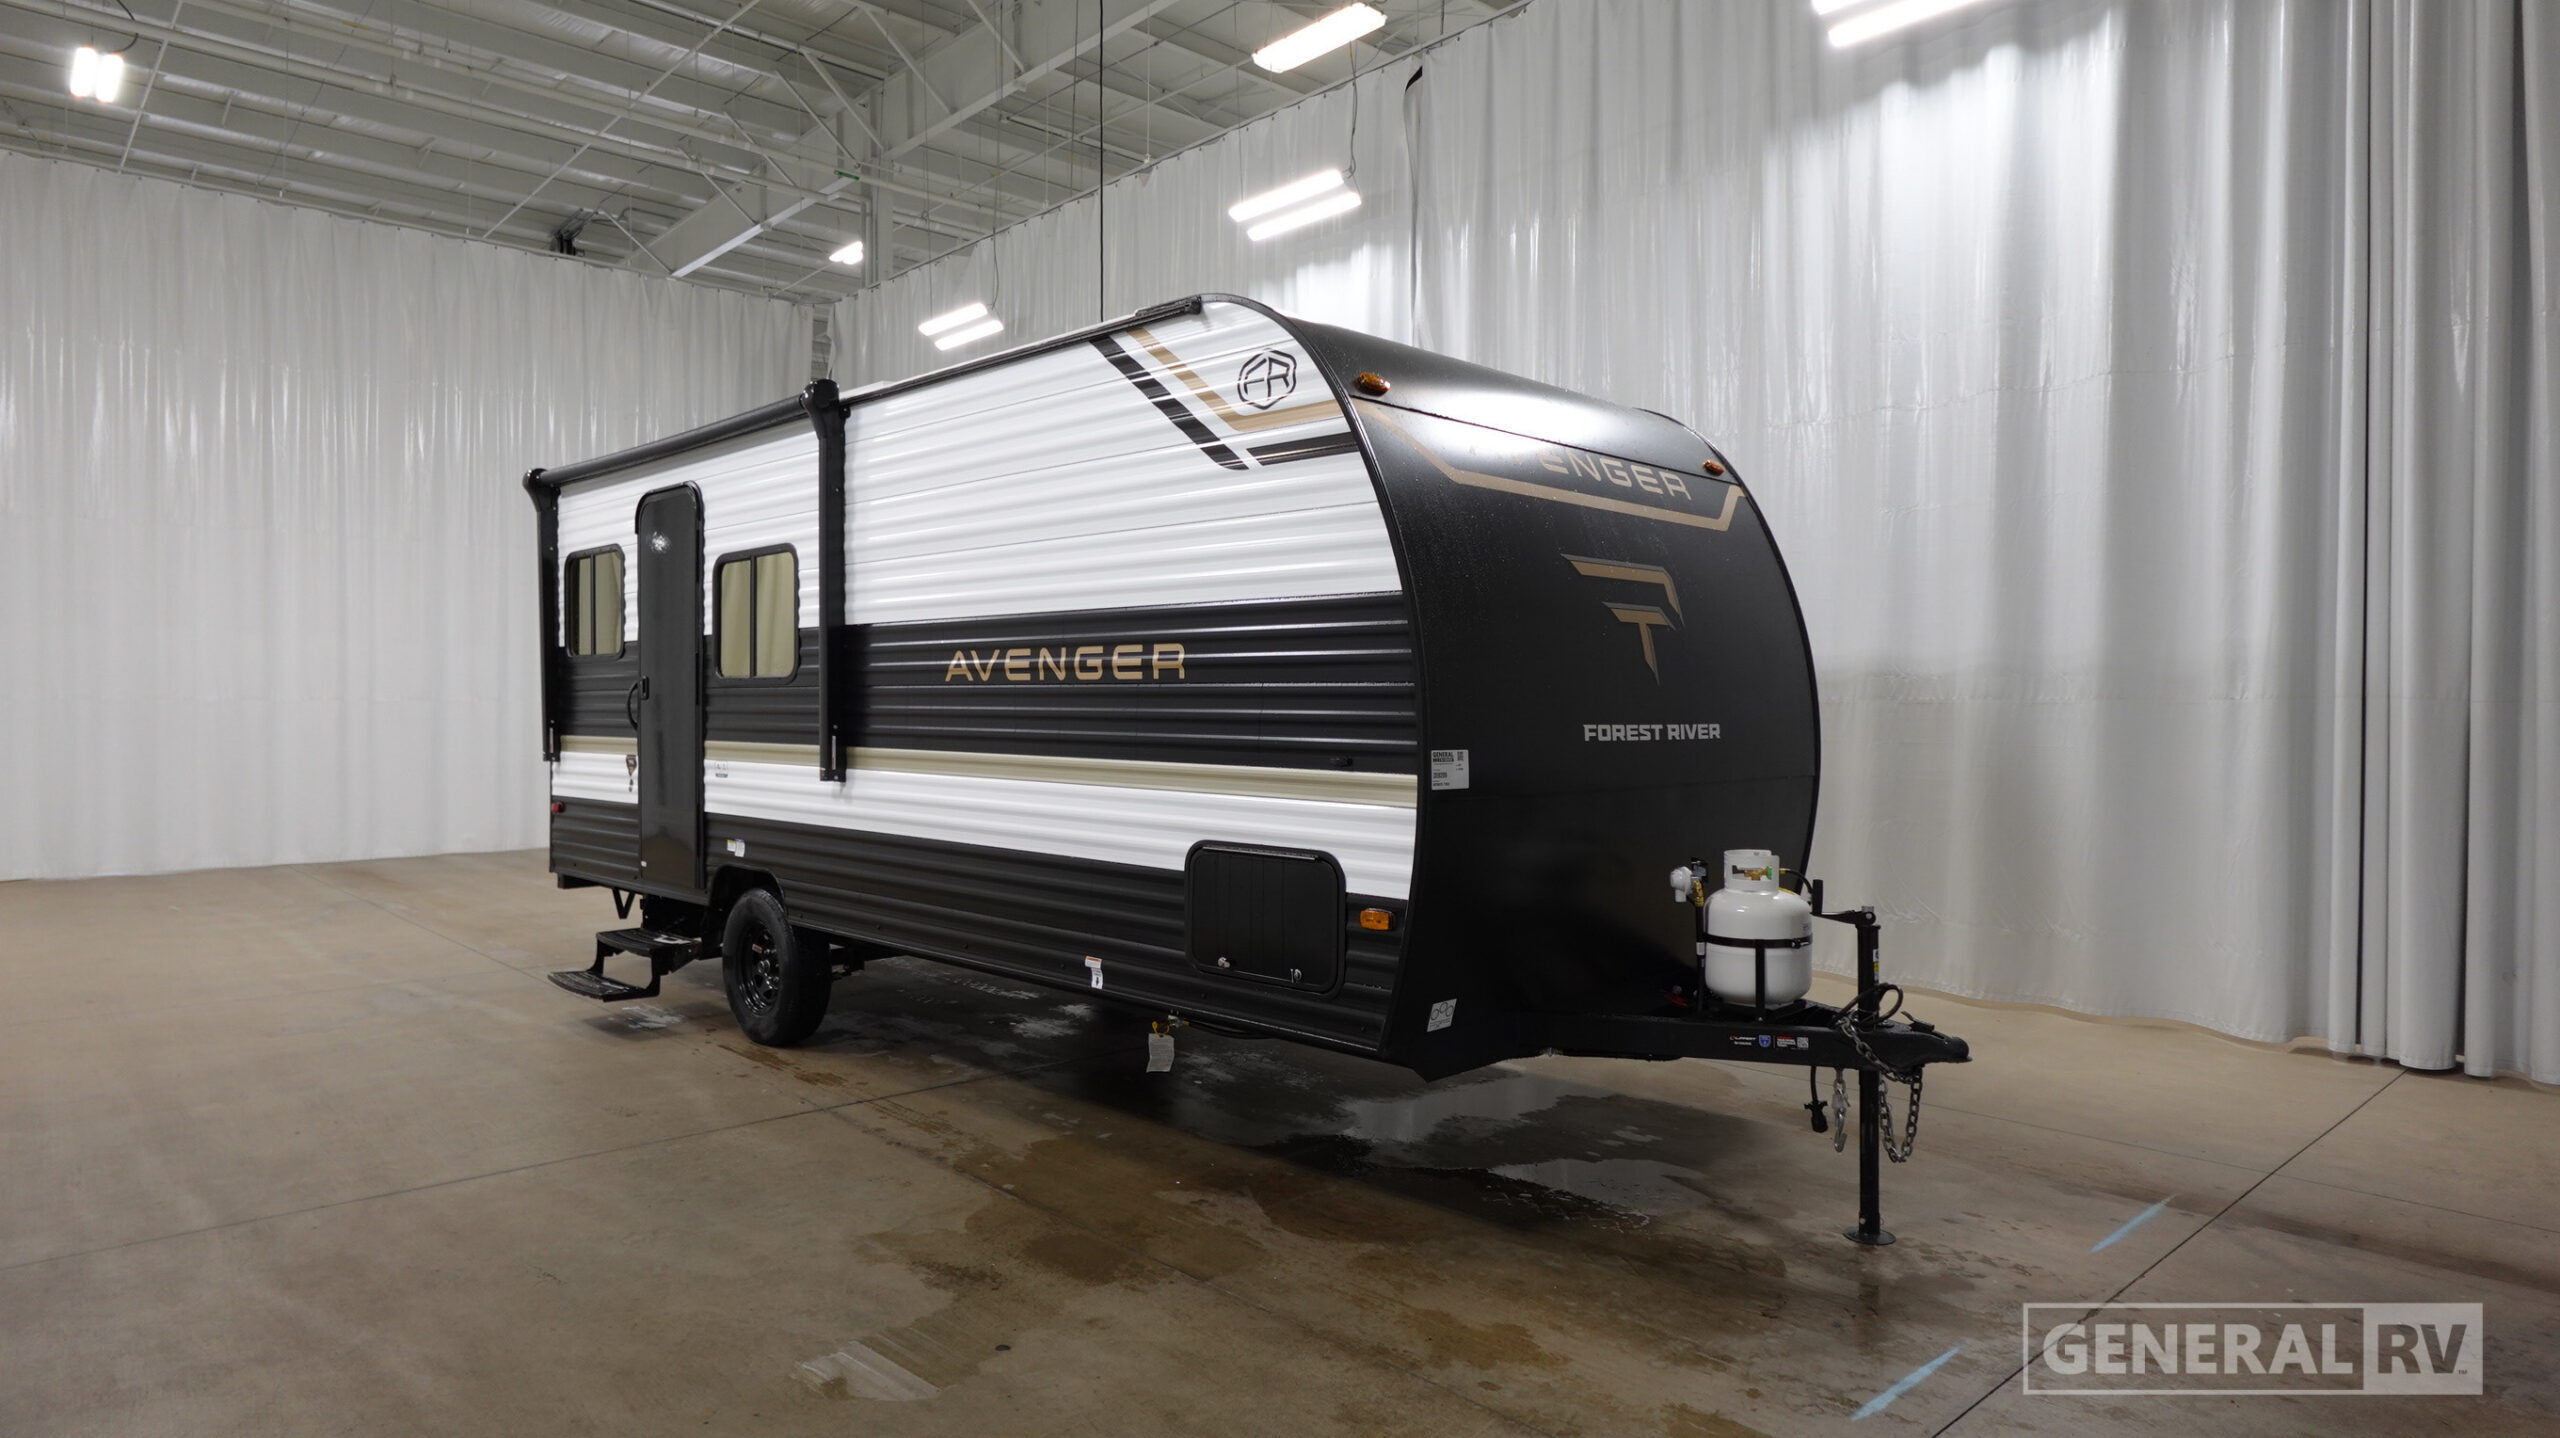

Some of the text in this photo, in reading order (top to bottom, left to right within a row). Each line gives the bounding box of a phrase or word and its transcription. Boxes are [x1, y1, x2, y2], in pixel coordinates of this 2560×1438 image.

[1513, 450, 1692, 500] ENGER
[945, 643, 1186, 682] AVENGER
[1583, 723, 1720, 742] FOREST RIVER
